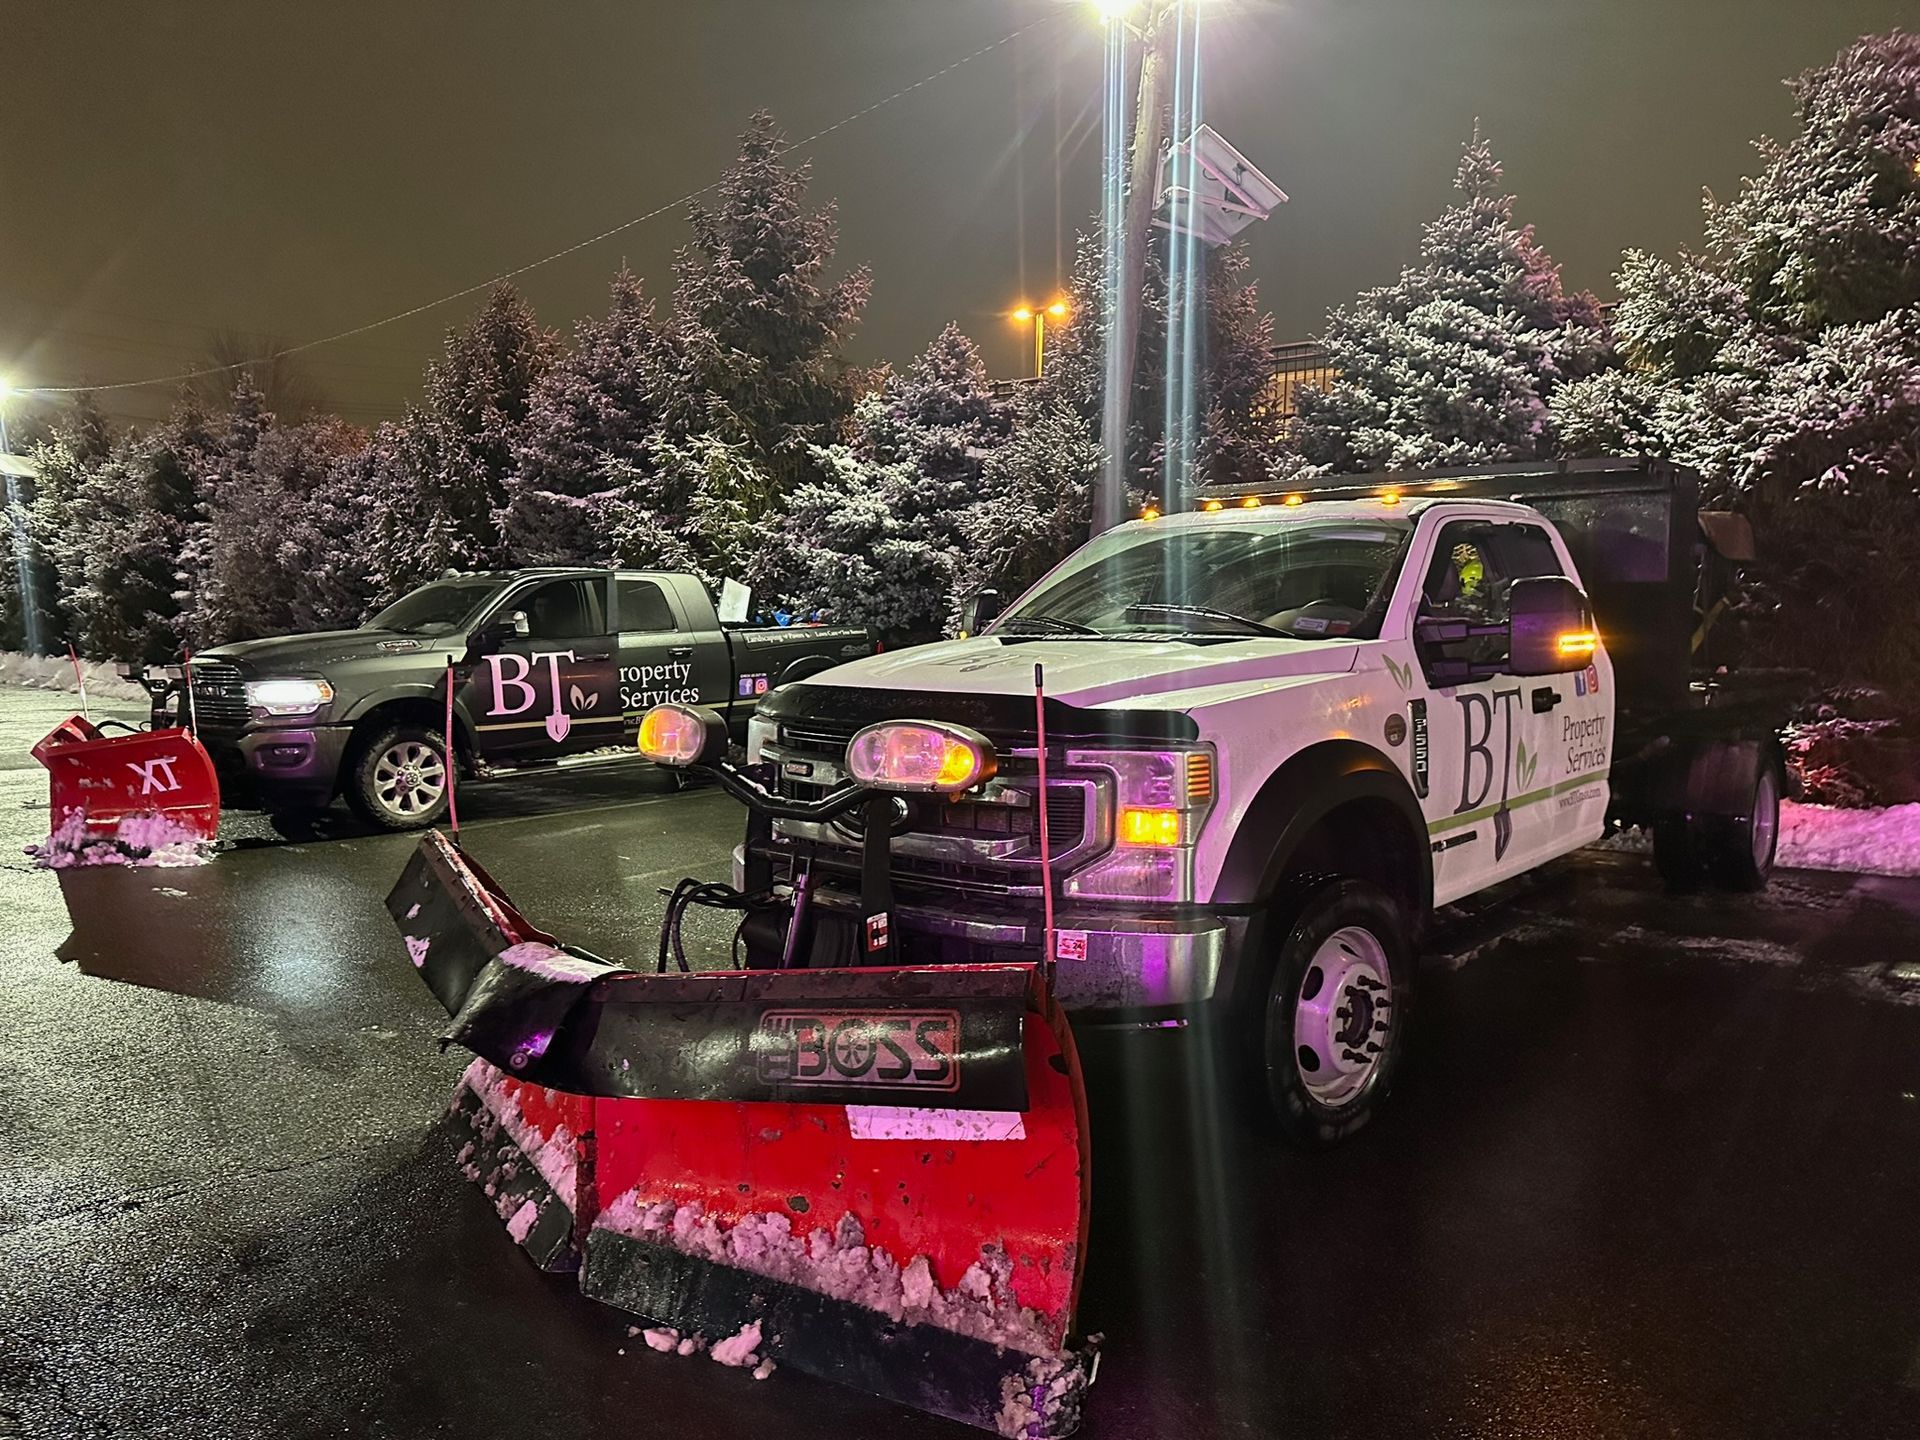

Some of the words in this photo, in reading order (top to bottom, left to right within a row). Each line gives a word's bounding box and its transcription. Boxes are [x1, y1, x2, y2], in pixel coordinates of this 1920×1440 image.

[481, 650, 575, 716] BT
[619, 660, 692, 688] roperty
[620, 684, 699, 709] Services
[1562, 713, 1606, 747] Property
[1453, 686, 1523, 815] BT
[1566, 743, 1606, 774] Services
[126, 756, 182, 795] XT
[789, 1018, 950, 1081] BOSS
